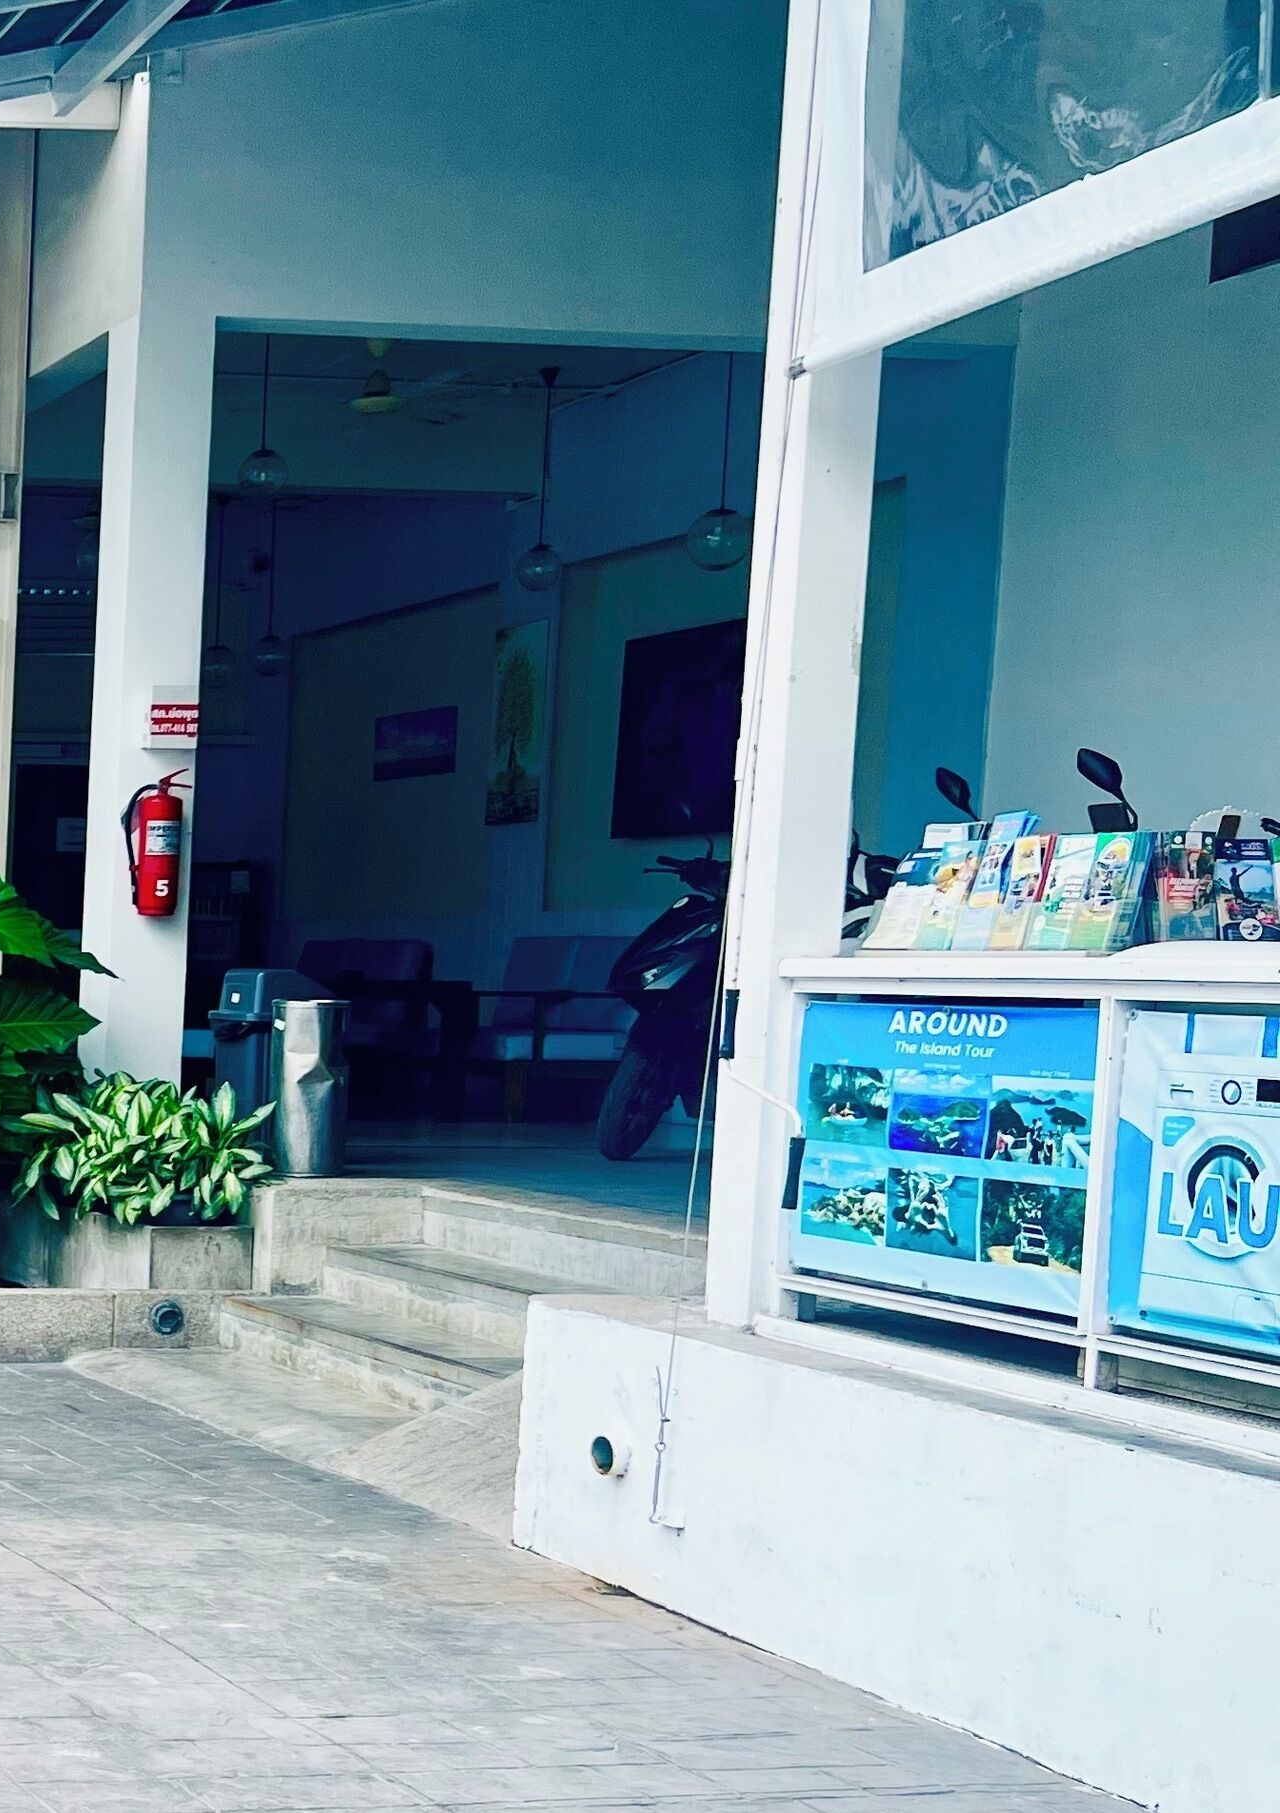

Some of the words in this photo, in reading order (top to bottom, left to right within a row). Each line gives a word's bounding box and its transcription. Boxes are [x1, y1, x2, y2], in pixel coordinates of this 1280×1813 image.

[154, 880, 169, 897] 5
[887, 1010, 1008, 1038] AROUND
[895, 1041, 917, 1054] The
[920, 1042, 962, 1057] Island
[965, 1044, 996, 1058] Tour
[1157, 1171, 1280, 1249] LAU
